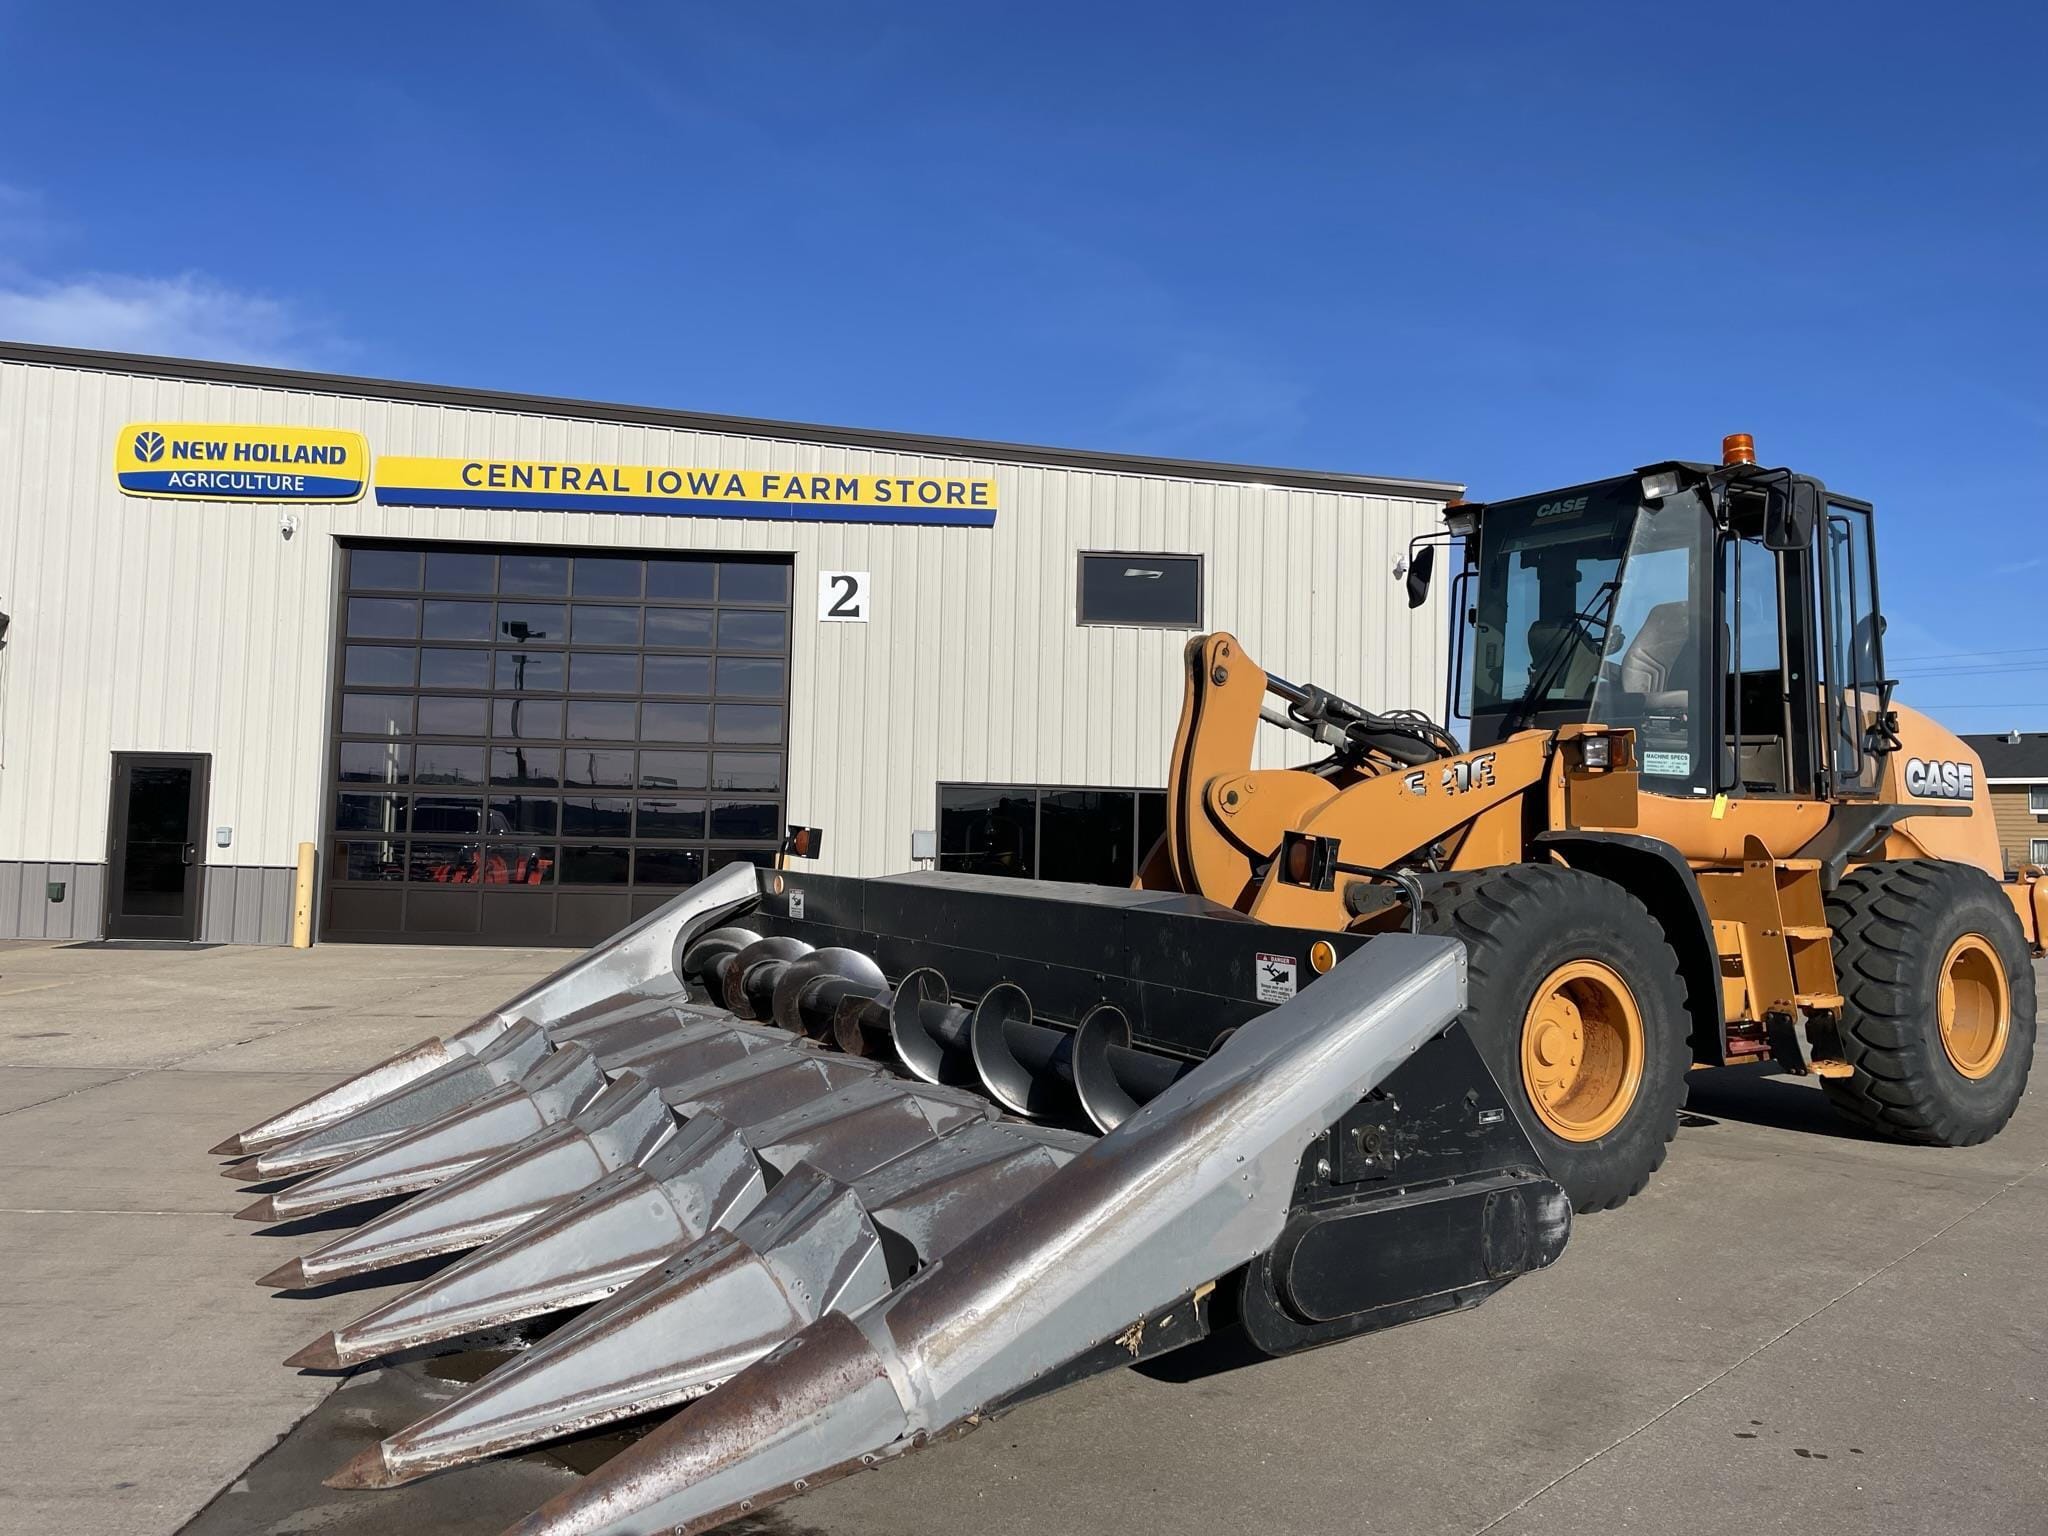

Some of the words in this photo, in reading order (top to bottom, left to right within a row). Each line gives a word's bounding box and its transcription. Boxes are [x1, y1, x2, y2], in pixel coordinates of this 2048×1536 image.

[172, 441, 227, 460] NEW
[234, 443, 346, 465] HOLLAND
[168, 472, 305, 491] AGRICULTURE
[462, 463, 630, 492] CENTRAL
[646, 470, 746, 497] IOWA
[762, 475, 859, 500] FARM
[874, 479, 988, 505] STORE
[1536, 496, 1589, 517] CASE
[827, 575, 860, 617] 2
[1905, 758, 1973, 800] CASE
